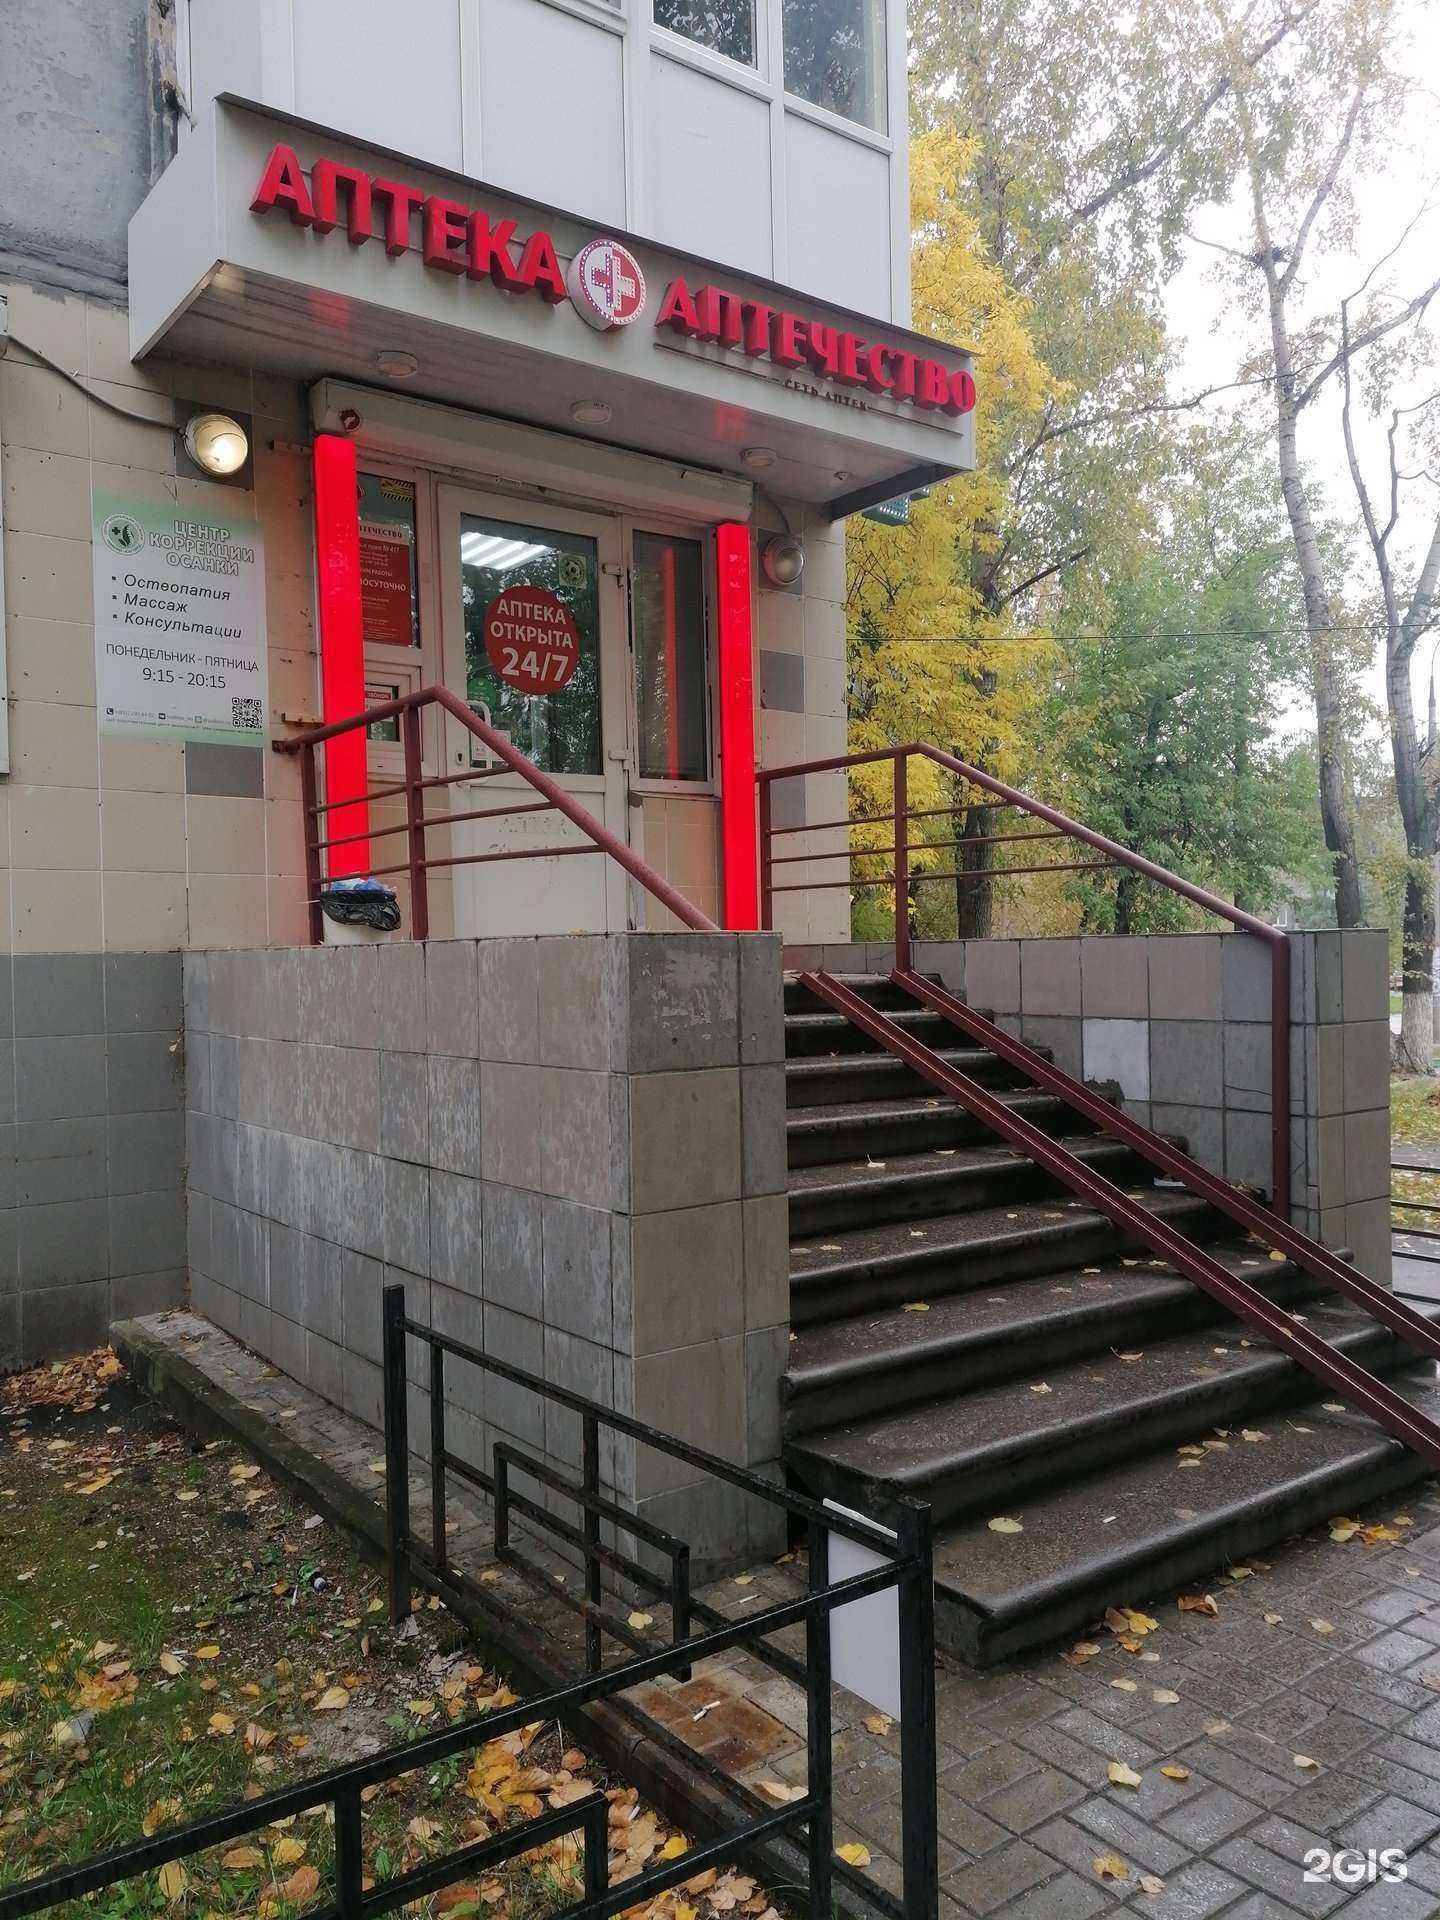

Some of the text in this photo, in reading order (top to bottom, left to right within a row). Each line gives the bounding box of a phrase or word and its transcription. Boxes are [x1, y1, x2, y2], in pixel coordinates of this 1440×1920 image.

[249, 142, 976, 417] АПТЕКА АПТЕЧЕСТВО
[784, 378, 866, 411] СЕТЬ АПТЕК
[173, 520, 230, 542] ЦЕНТР
[149, 532, 255, 563] КОРРЕКЦИИ
[166, 552, 239, 576] ОСАНКИ
[124, 574, 231, 600] Остеопатия
[124, 593, 188, 613] Массаж
[497, 598, 567, 625] АПТЕКА
[124, 612, 242, 639] Консультации
[490, 620, 574, 649] ОТКРЫТА
[106, 643, 196, 664] ПОНЕДЕЛЬНИК
[205, 655, 259, 672] ПЯТНИЦА
[502, 646, 569, 682] 24/7
[142, 667, 175, 683] 9:15
[187, 672, 226, 689] 20:15
